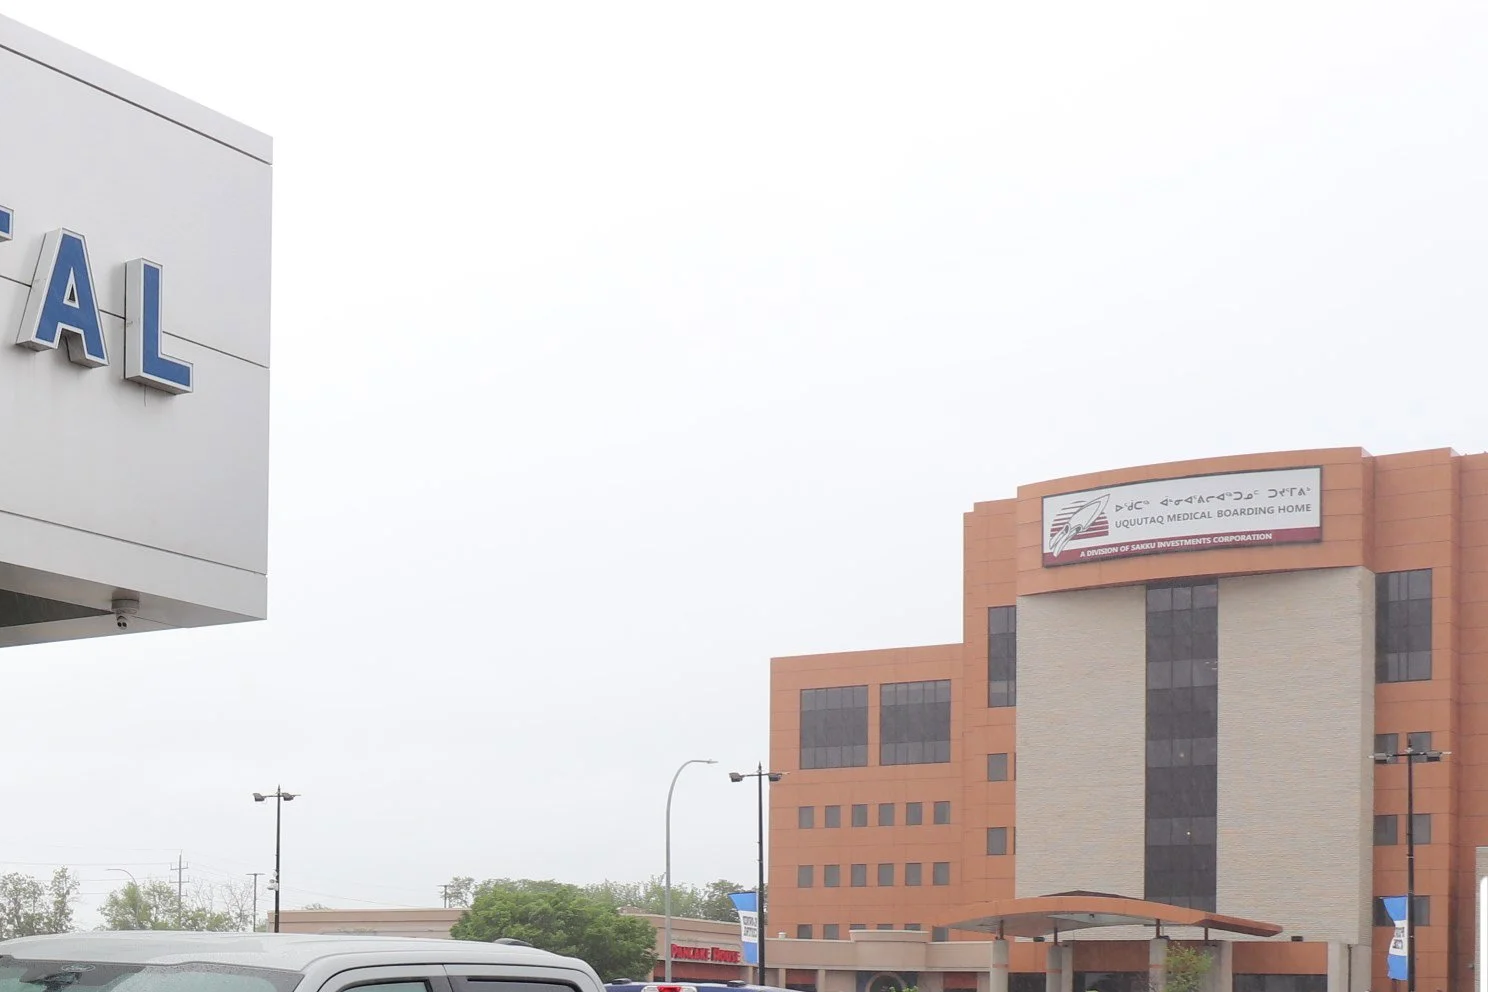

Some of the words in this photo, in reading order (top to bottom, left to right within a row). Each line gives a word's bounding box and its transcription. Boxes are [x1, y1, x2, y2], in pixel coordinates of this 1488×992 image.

[1115, 515, 1164, 528] UQUUTAQ
[1167, 511, 1212, 523] MEDICAL
[1217, 506, 1275, 518] BOARDING
[1278, 504, 1312, 514] HOME
[1087, 547, 1119, 556] DIVISION
[1131, 542, 1156, 551] SAKKU
[1157, 537, 1212, 548] INVESTMENTS
[1213, 533, 1273, 543] CORPORATION
[671, 944, 710, 960] PANCAKE
